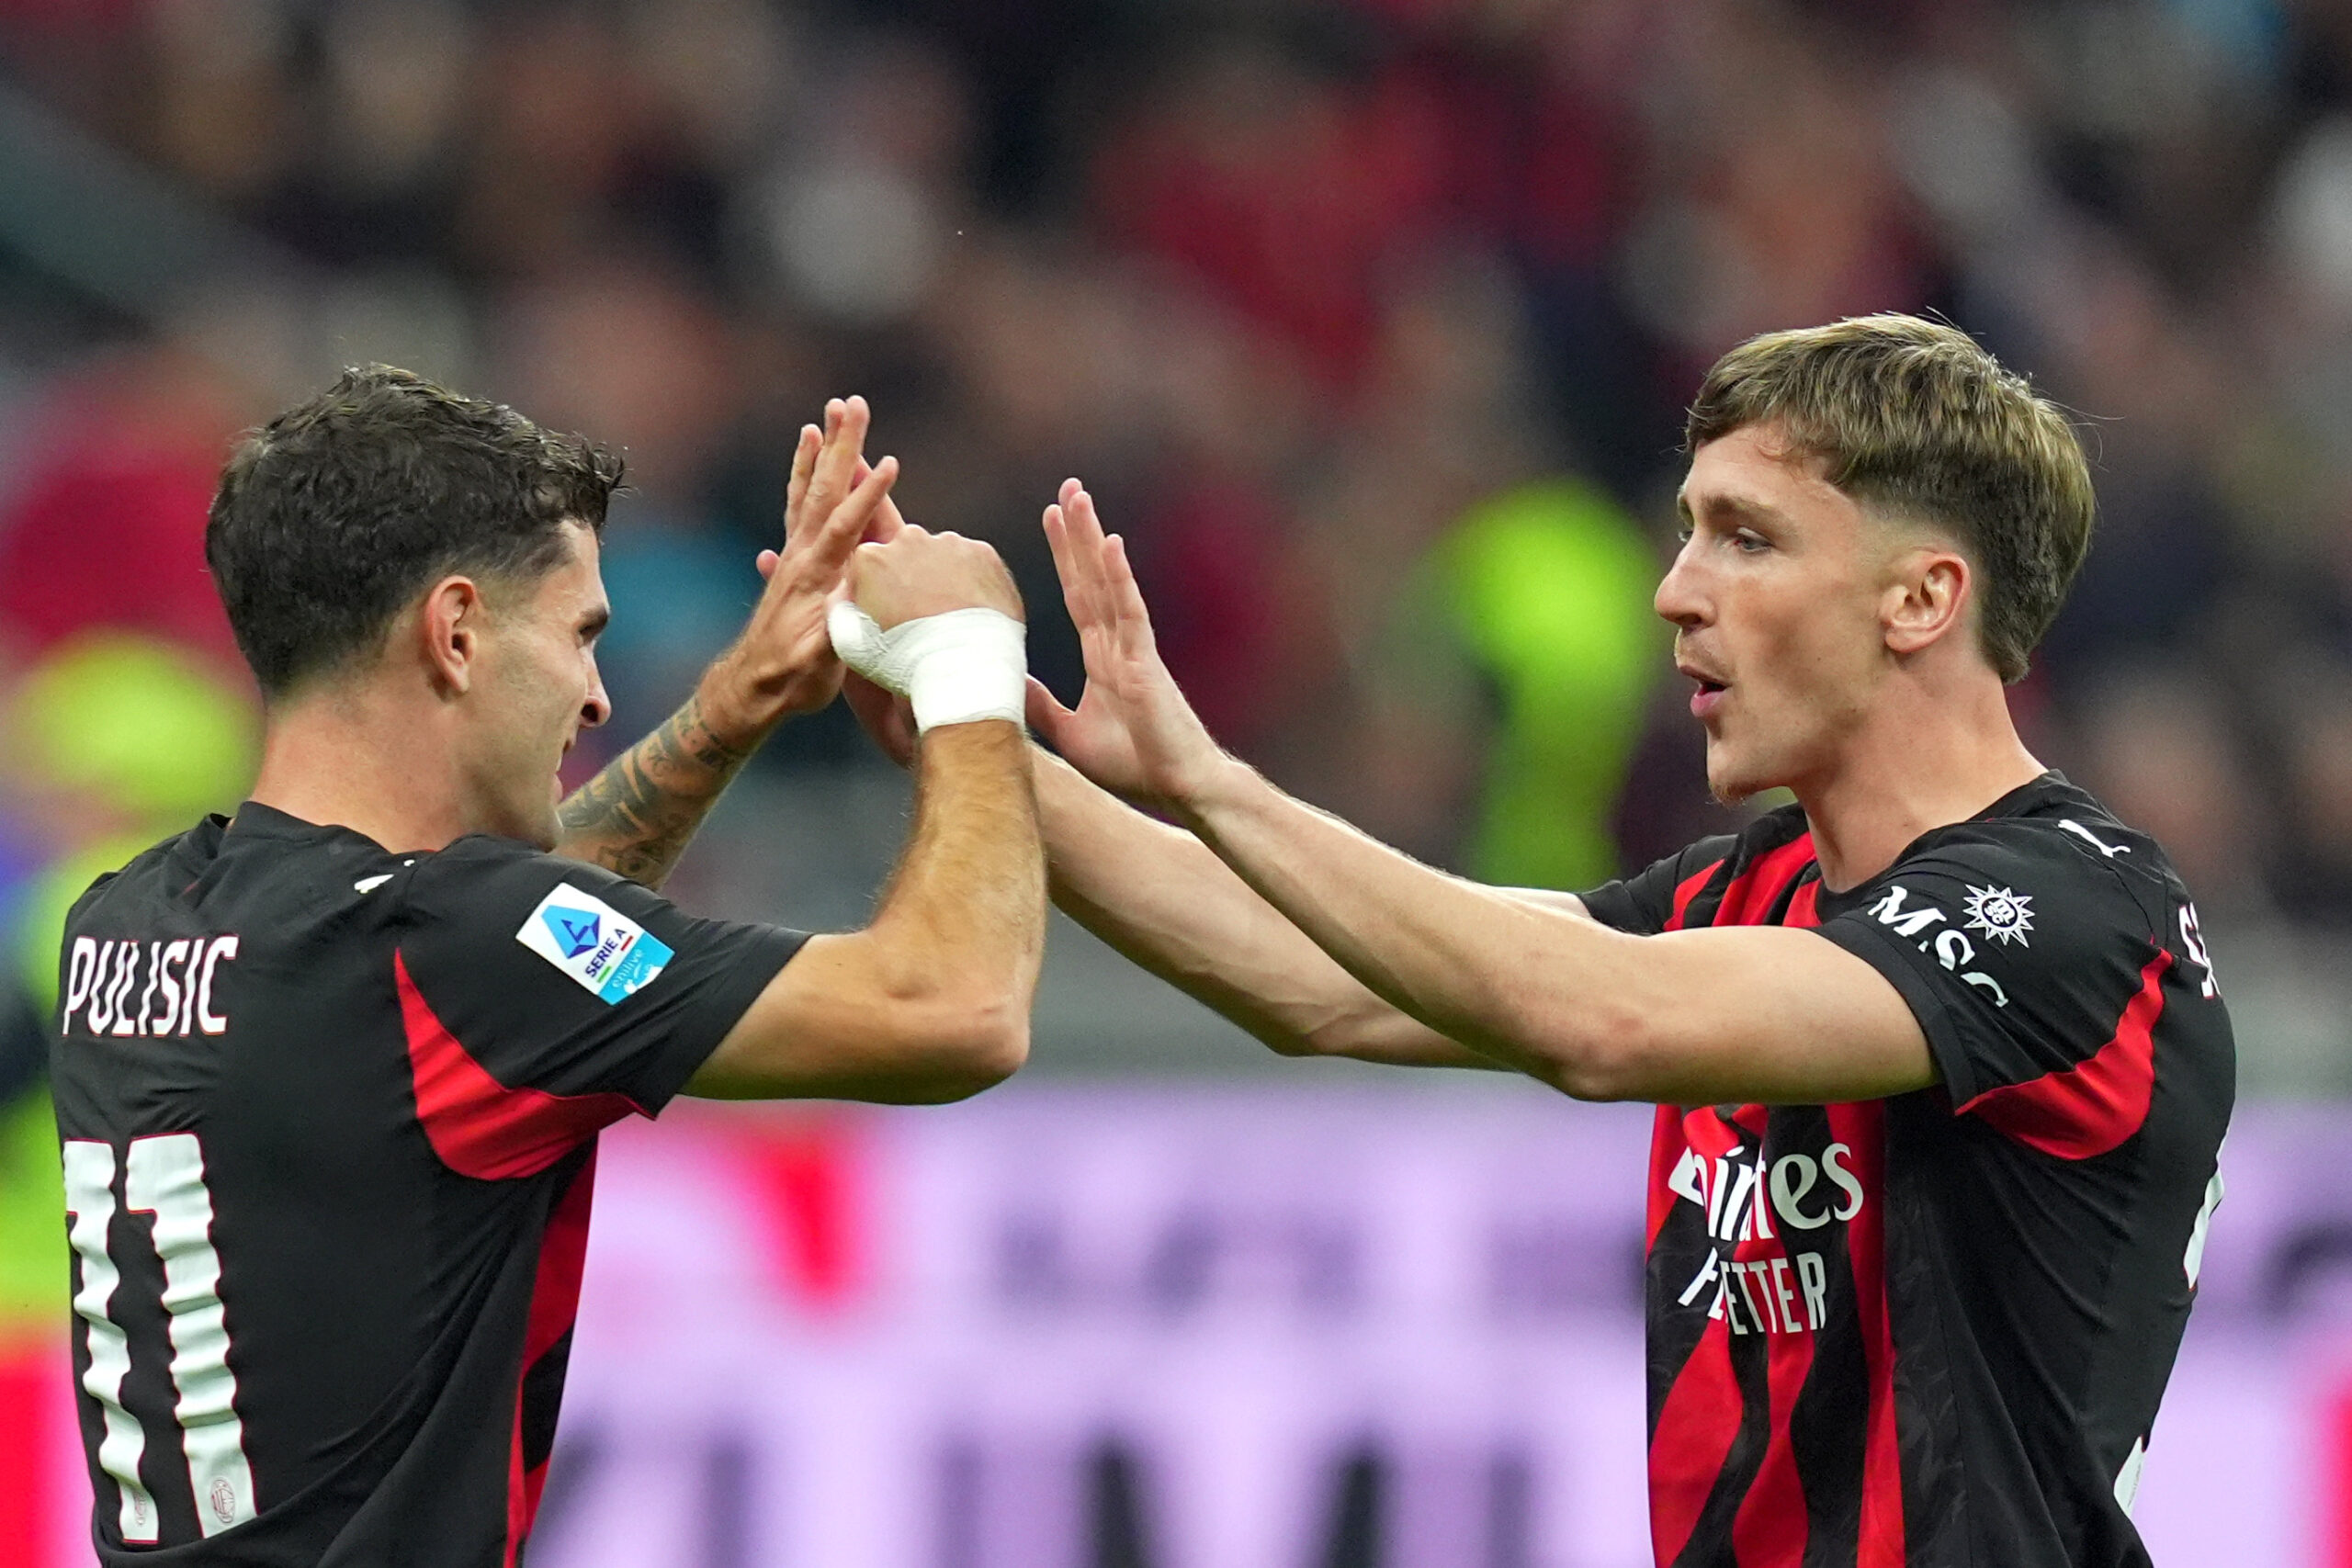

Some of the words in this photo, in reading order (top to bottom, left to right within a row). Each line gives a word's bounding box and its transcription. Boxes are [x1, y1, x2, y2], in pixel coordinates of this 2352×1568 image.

[62, 933, 239, 1037] PULISIC
[585, 937, 618, 977] SERIE
[614, 928, 628, 940] A
[63, 1133, 258, 1544] 11
[1719, 1251, 1826, 1336] ETTER
